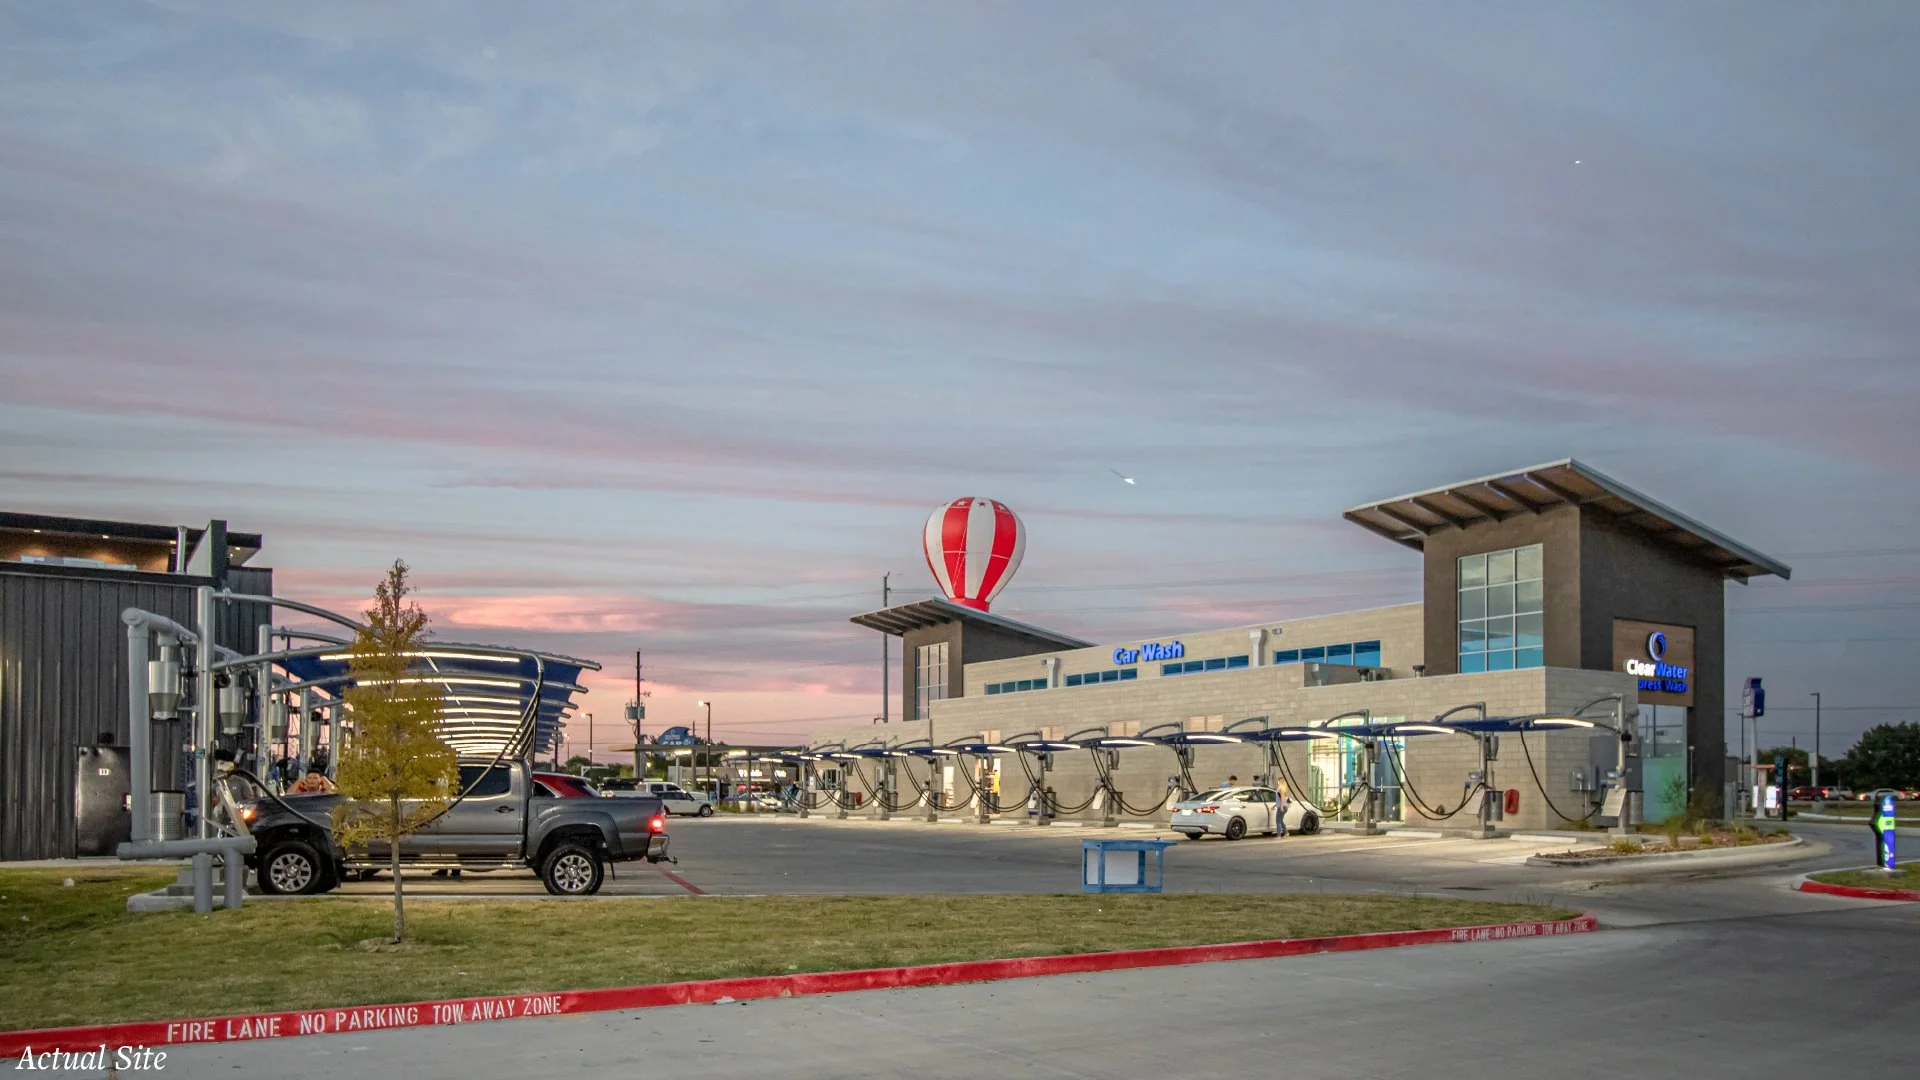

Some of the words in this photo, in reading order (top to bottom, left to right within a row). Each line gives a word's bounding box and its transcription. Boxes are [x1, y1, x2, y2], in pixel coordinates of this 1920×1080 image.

[1113, 647, 1138, 665] Car
[1141, 640, 1184, 662] Wash
[1625, 659, 1688, 680] ClearWater
[1638, 679, 1662, 692] press
[1664, 680, 1688, 693] Wash
[1471, 928, 1490, 941] LANE
[1495, 926, 1505, 939] NO
[1507, 925, 1536, 937] PARKING
[1542, 923, 1553, 935] TOW
[1555, 922, 1572, 934] AWAY
[1574, 920, 1589, 932] ZONE
[167, 1021, 216, 1043] FIRE
[226, 1017, 282, 1039] LANE
[300, 1013, 326, 1035] NO
[335, 1007, 418, 1031] PARKING
[432, 1003, 464, 1024] TOW
[471, 1000, 515, 1021] AWAY
[523, 996, 561, 1016] ZONE
